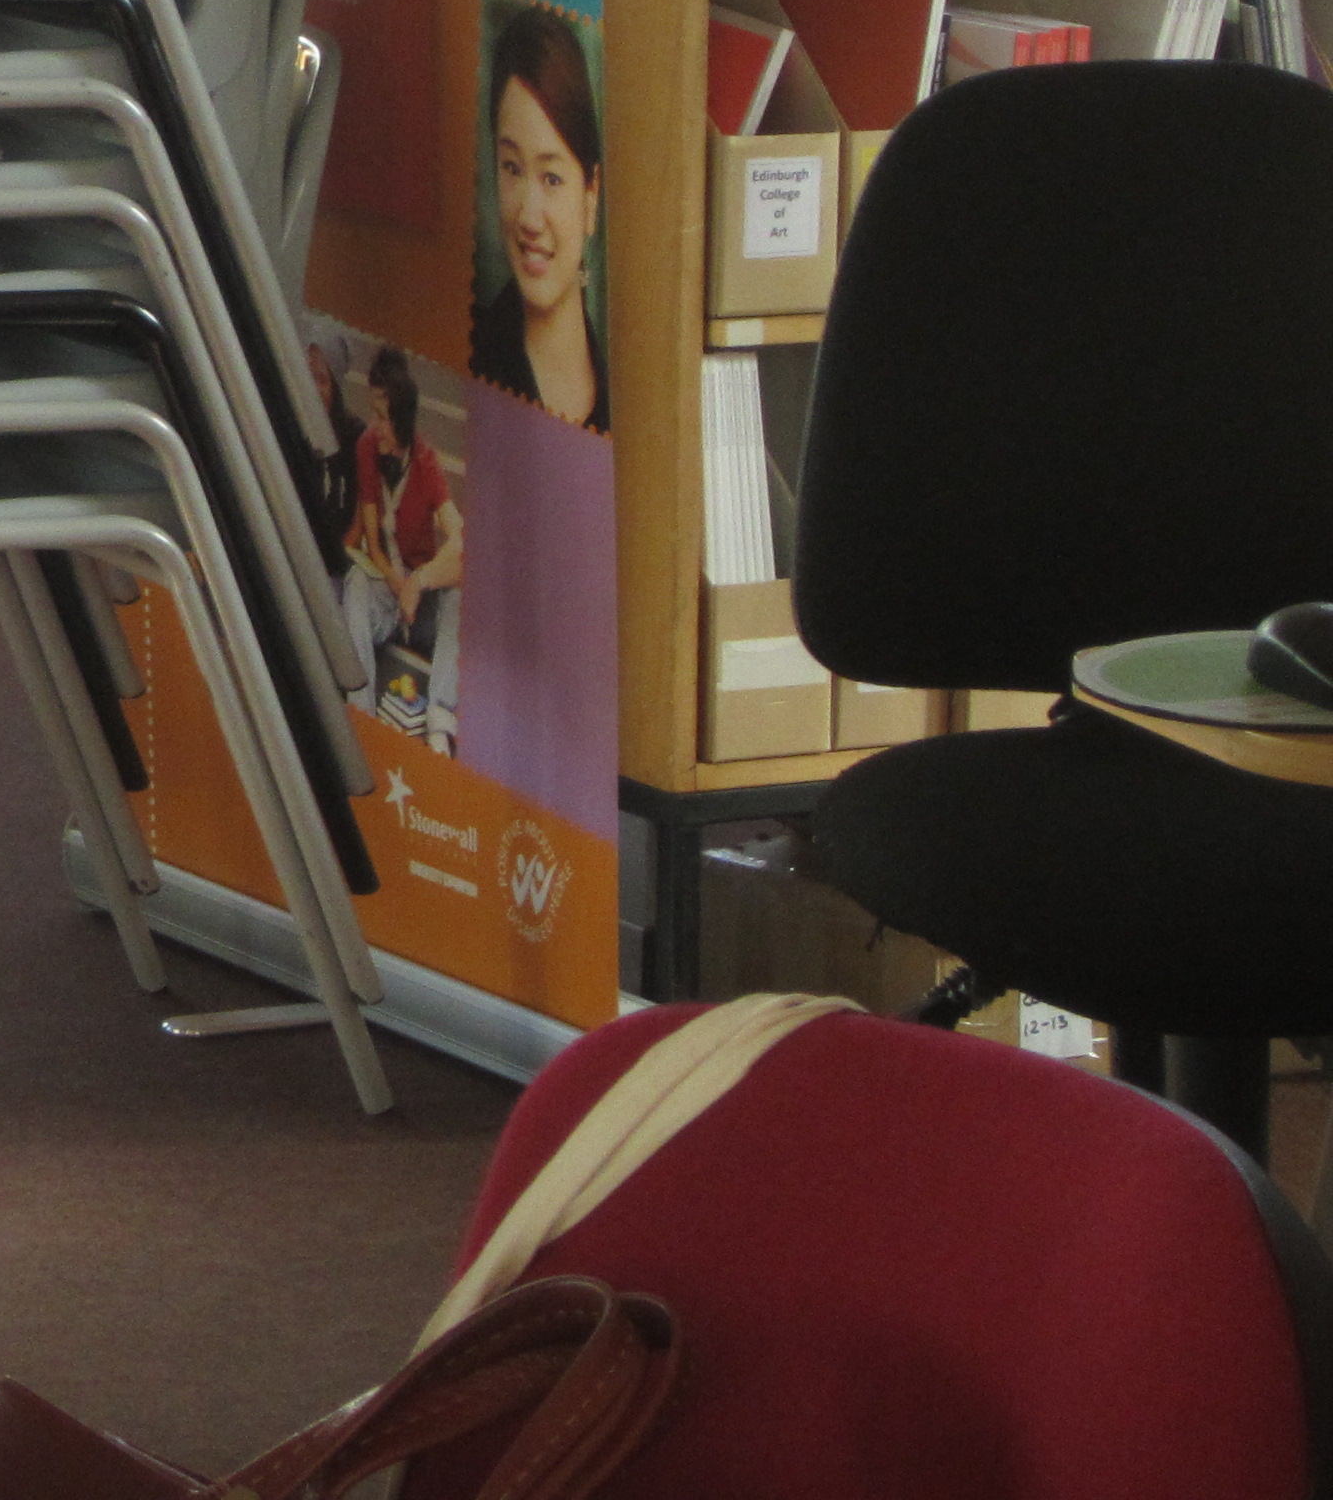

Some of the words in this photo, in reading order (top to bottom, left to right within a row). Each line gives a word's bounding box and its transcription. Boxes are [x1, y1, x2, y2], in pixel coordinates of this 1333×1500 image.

[751, 168, 810, 183] Edinburgh
[759, 189, 801, 202] College
[773, 206, 786, 219] of
[770, 227, 788, 238] Art
[408, 805, 479, 854] Stonewall
[1023, 1015, 1069, 1037] 12-13
